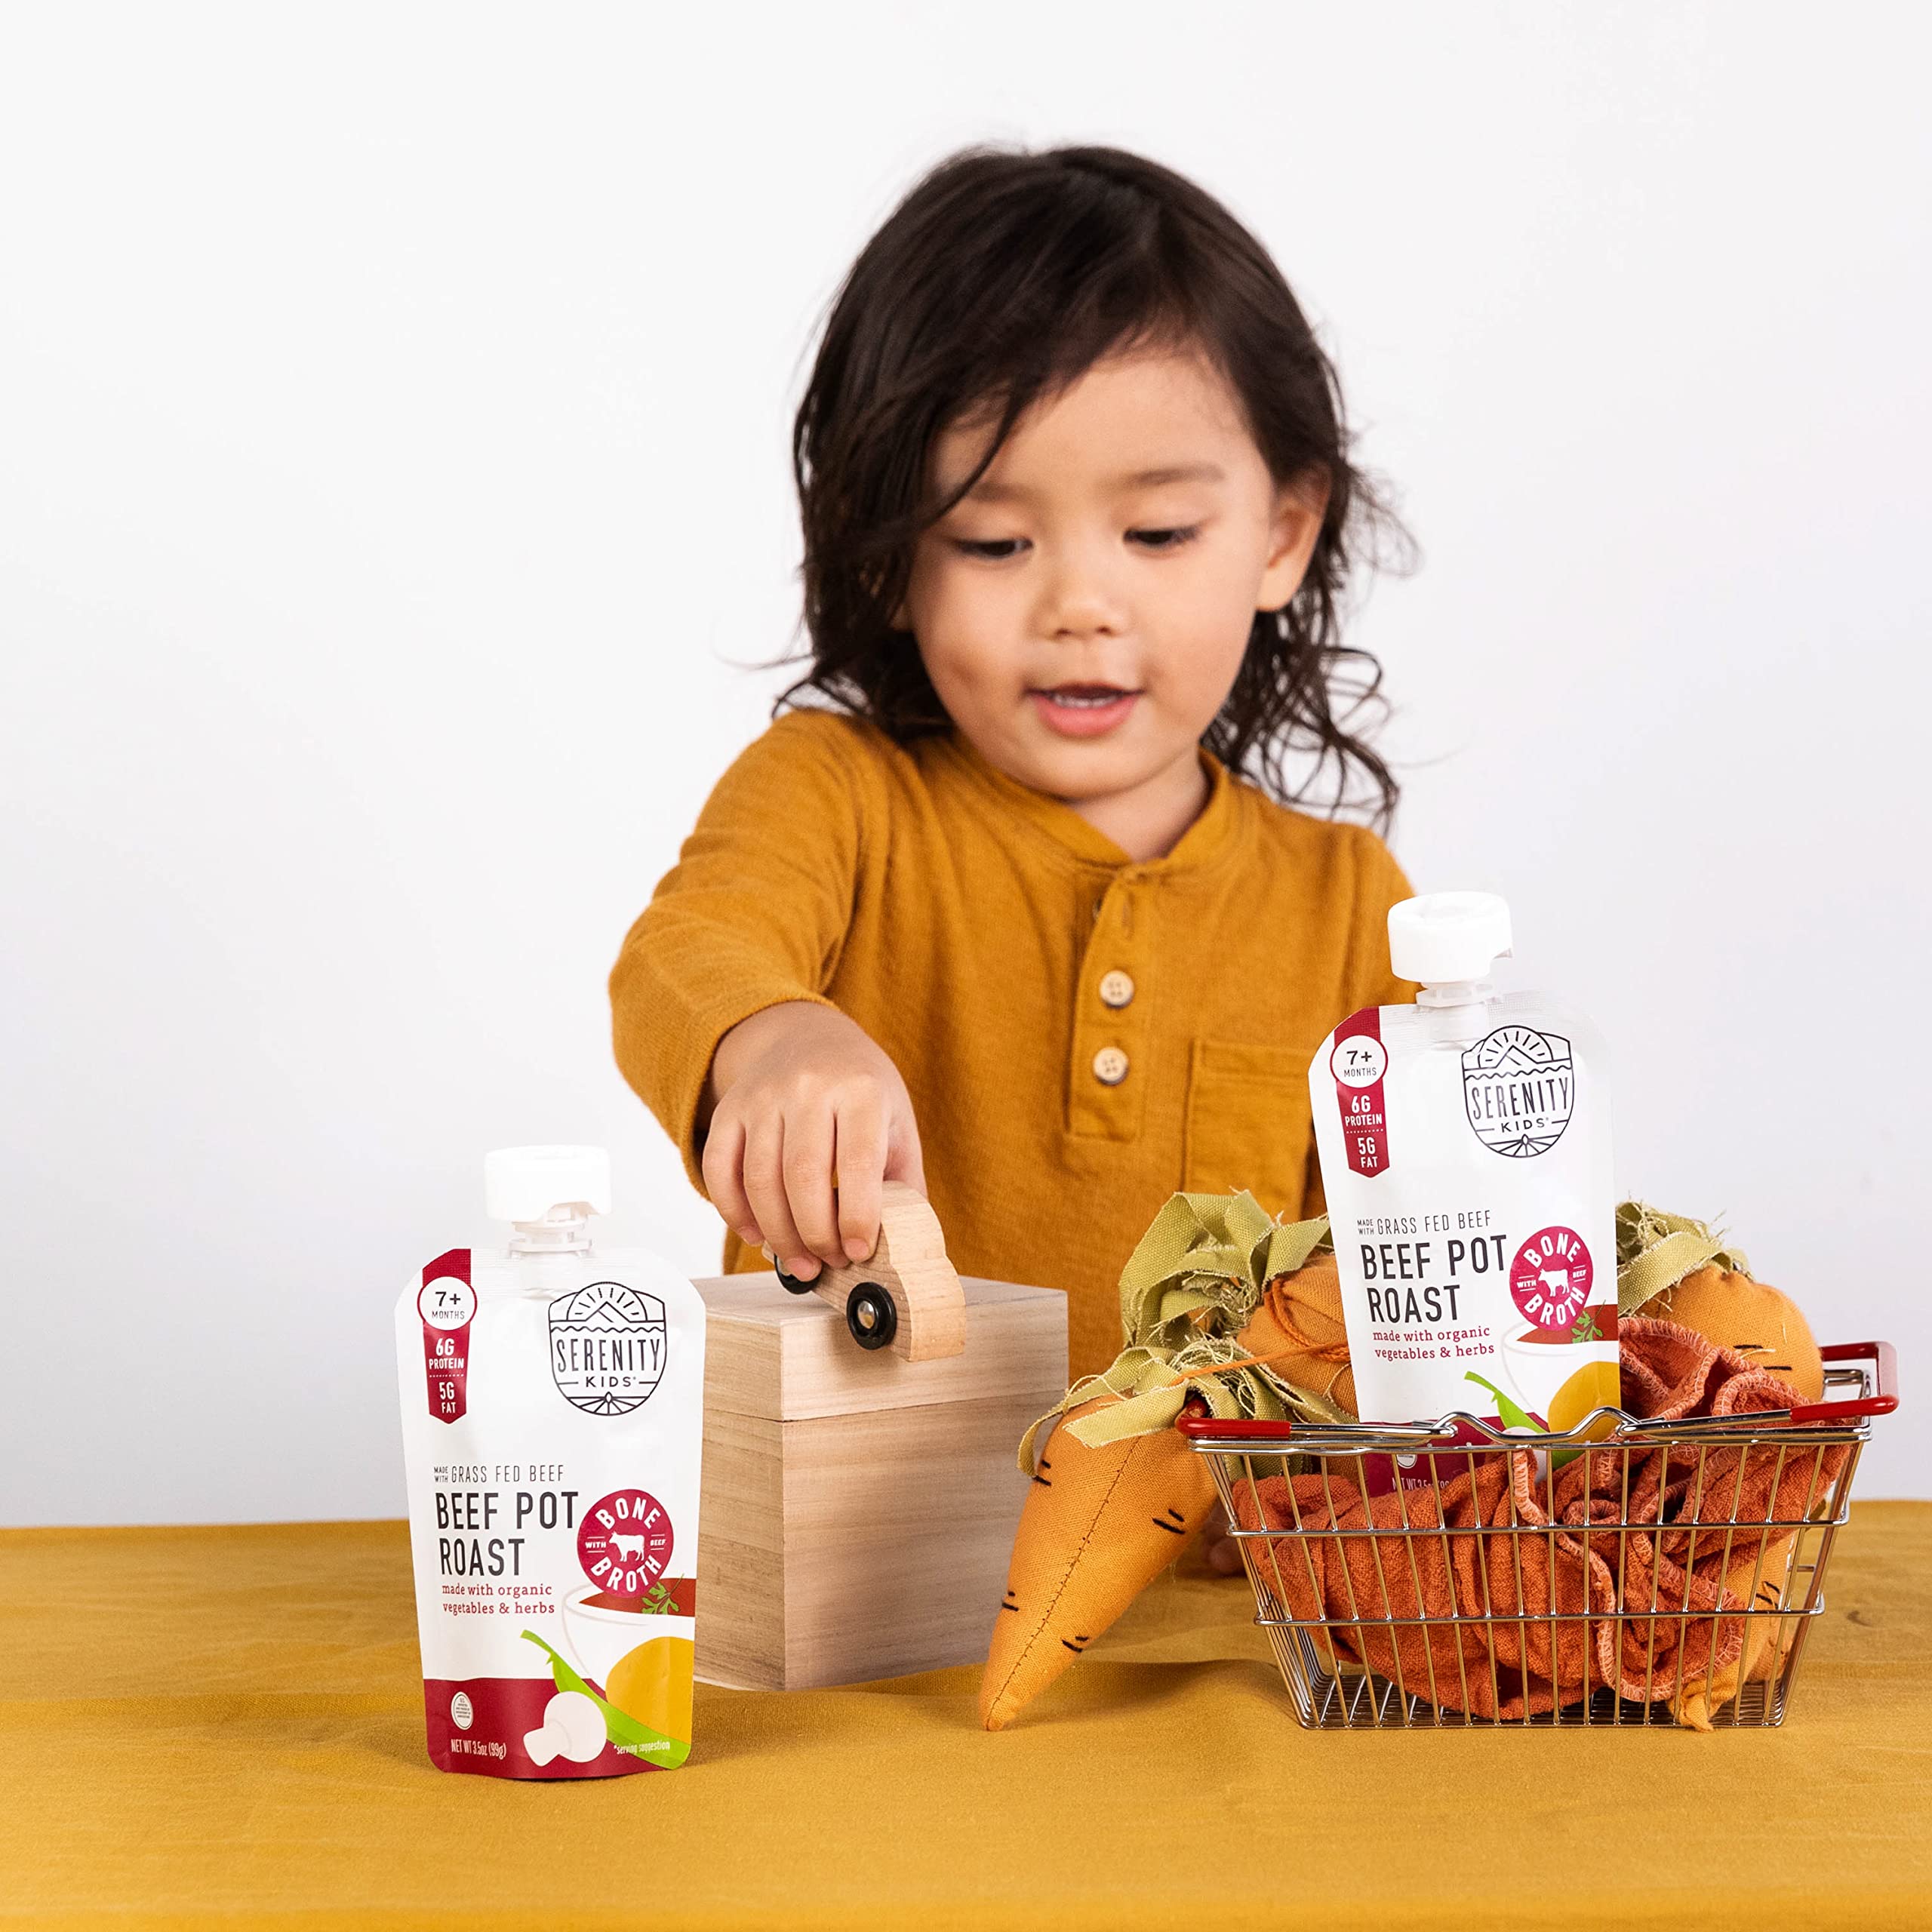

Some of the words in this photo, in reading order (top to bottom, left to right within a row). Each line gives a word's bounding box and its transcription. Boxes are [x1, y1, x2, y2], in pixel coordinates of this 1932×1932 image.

[1346, 1050, 1373, 1066] 7+
[1343, 1067, 1377, 1078] MONTHS
[1351, 1094, 1371, 1113] 6G
[1472, 1077, 1568, 1121] SERENITY
[1345, 1114, 1383, 1126] PROTEIN
[1358, 1137, 1376, 1155] 5G
[1361, 1156, 1378, 1168] FAT
[1377, 1217, 1417, 1235] GRASS
[1425, 1214, 1450, 1232] FED
[1458, 1210, 1491, 1229] BEEF
[1360, 1241, 1431, 1280] BEEF
[1447, 1234, 1507, 1276] POT
[1523, 1232, 1581, 1269] BONE
[1572, 1269, 1586, 1278] BEEF
[1516, 1280, 1537, 1288] WITH
[434, 1291, 461, 1307] 7+
[1366, 1284, 1460, 1324] ROAST
[1524, 1286, 1586, 1325] BROTH
[431, 1309, 466, 1320] MONTHS
[1373, 1330, 1401, 1342] made
[1404, 1329, 1433, 1342] with
[1437, 1325, 1491, 1343] organic
[435, 1338, 455, 1357] 6G
[557, 1339, 661, 1374] SERENITY
[1374, 1347, 1435, 1361] vegetables
[1440, 1346, 1451, 1358] &
[1456, 1343, 1495, 1357] herbs
[429, 1358, 465, 1370] PROTEIN
[439, 1382, 455, 1400] 5G
[441, 1401, 457, 1414] FAT
[434, 1475, 448, 1483] WITH
[451, 1466, 488, 1483] GRASS
[496, 1466, 521, 1482] FED
[530, 1464, 564, 1481] BEEF
[1392, 1477, 1405, 1491] NT
[435, 1492, 499, 1530] BEEF
[516, 1491, 579, 1530] POT
[595, 1497, 661, 1530] BONE
[439, 1537, 525, 1577] ROAST
[590, 1555, 662, 1592] BROTH
[441, 1582, 466, 1595] made
[467, 1583, 494, 1595] with
[497, 1583, 552, 1599] organic
[442, 1601, 494, 1616] vegetables
[499, 1602, 510, 1614] &
[515, 1601, 555, 1614] herbs
[451, 1738, 463, 1753] NET
[463, 1740, 472, 1754] WT
[472, 1740, 488, 1756] 3.5oz
[488, 1742, 507, 1759] (99g)
